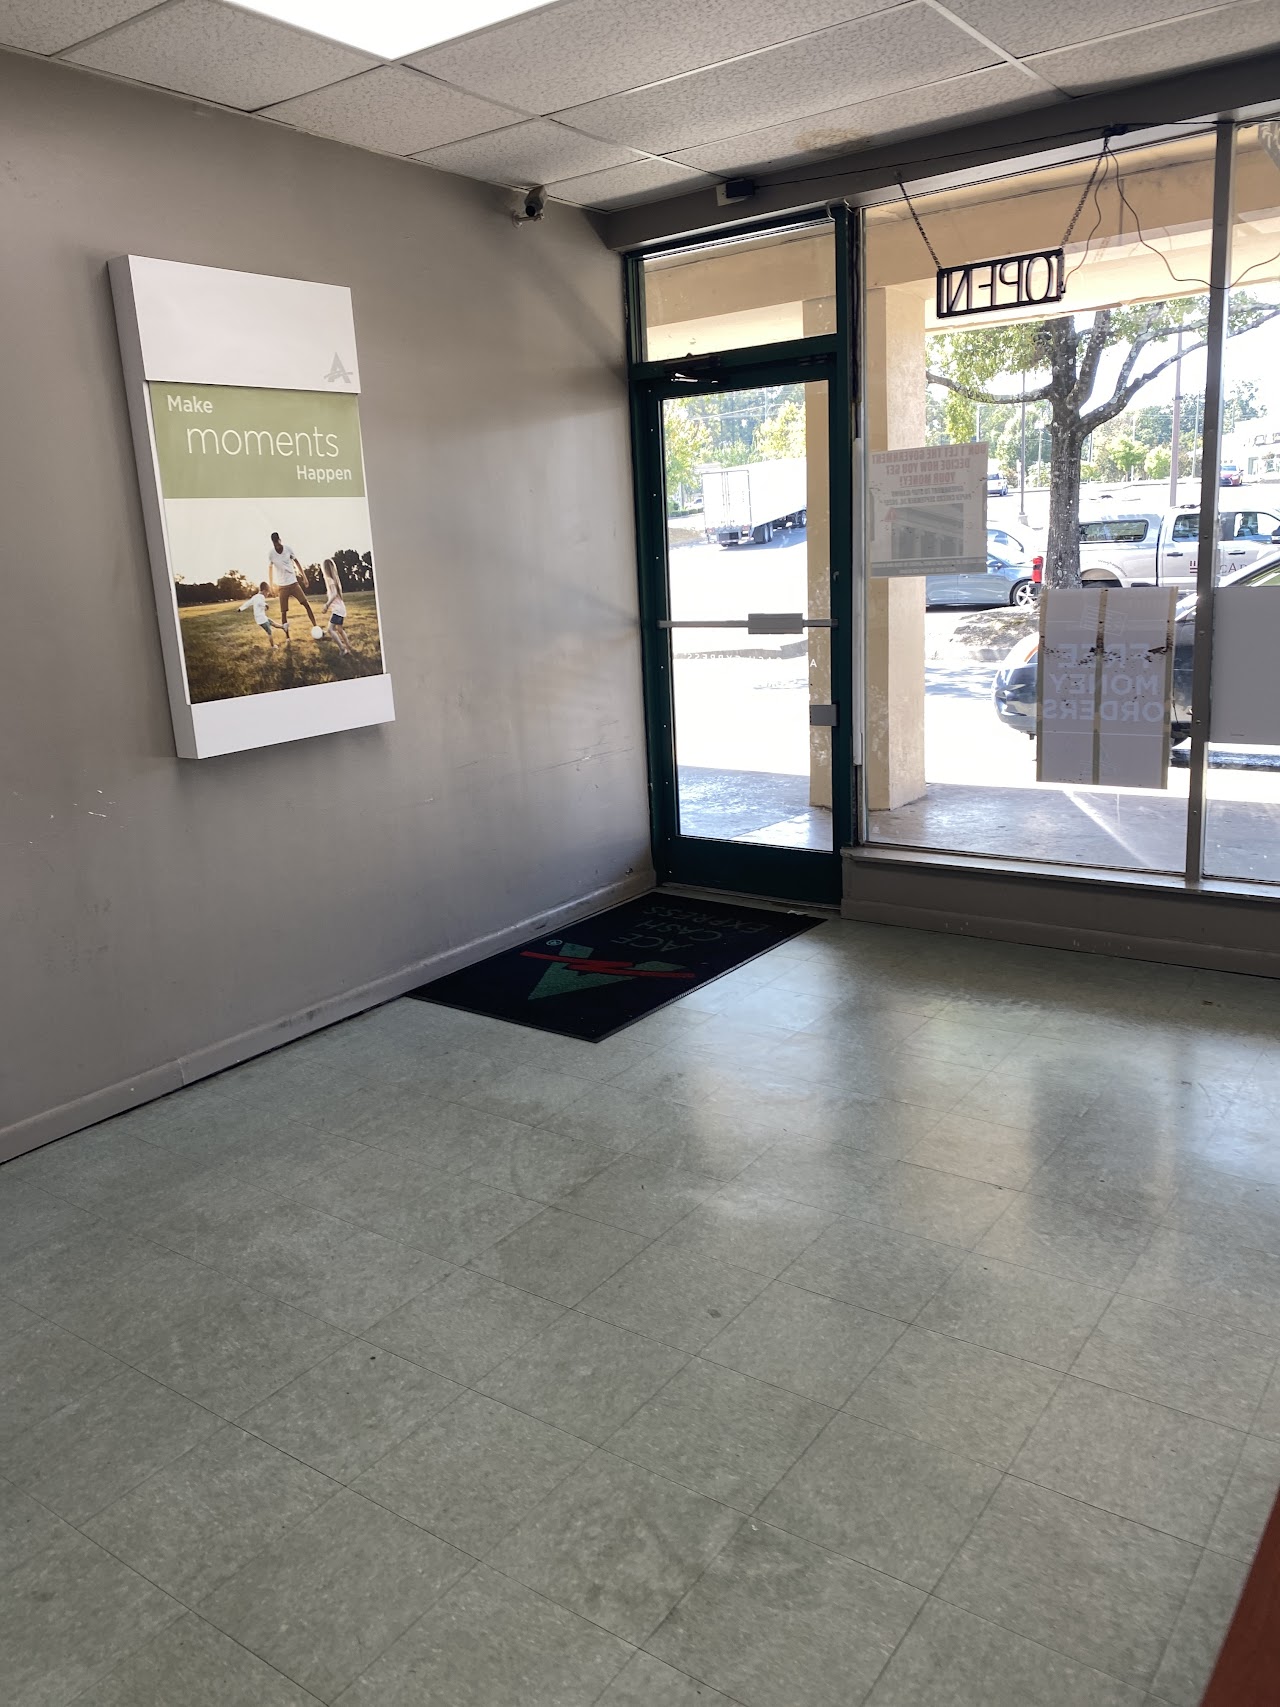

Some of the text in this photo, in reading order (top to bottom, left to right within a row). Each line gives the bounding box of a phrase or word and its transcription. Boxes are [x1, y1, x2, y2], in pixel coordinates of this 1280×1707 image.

[167, 394, 213, 413] Make
[187, 426, 340, 457] moments
[296, 465, 353, 483] Happen
